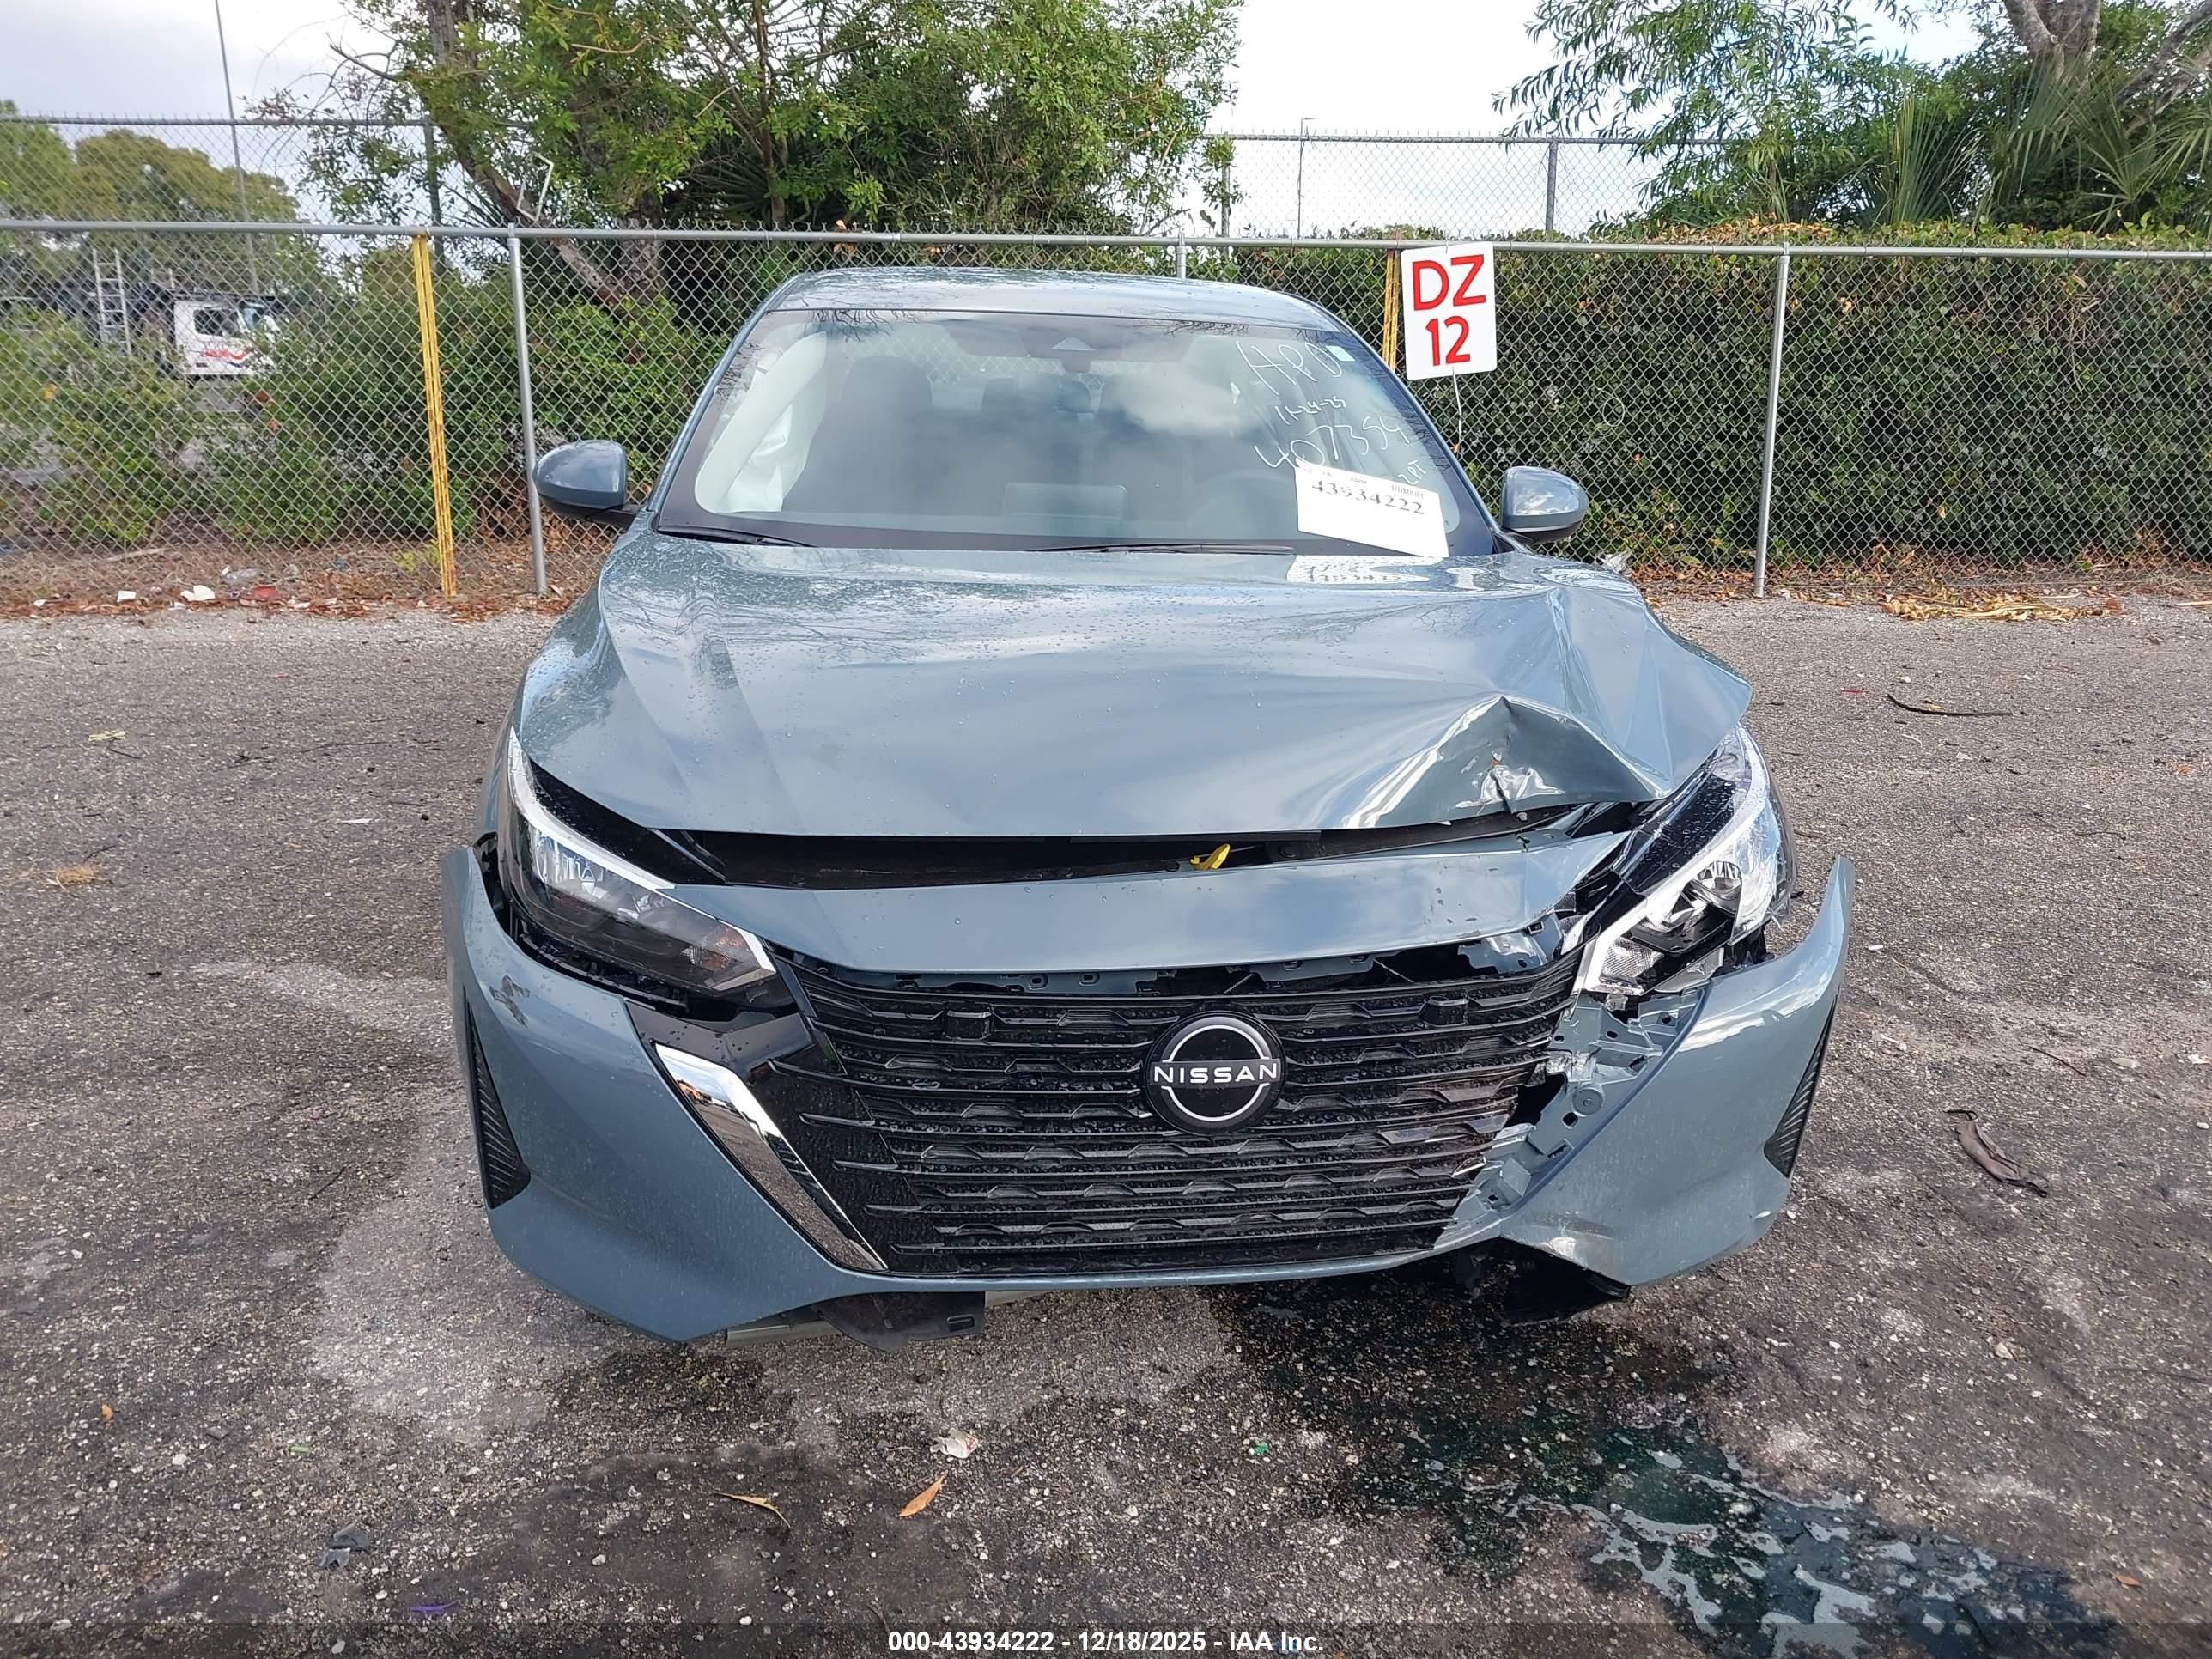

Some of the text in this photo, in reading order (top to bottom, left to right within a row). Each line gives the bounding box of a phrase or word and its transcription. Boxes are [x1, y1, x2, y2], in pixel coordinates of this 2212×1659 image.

[1413, 254, 1486, 311] DZ
[1425, 315, 1471, 367] 12
[1311, 480, 1425, 514] 43934222
[1153, 1062, 1278, 1084] NISSAN
